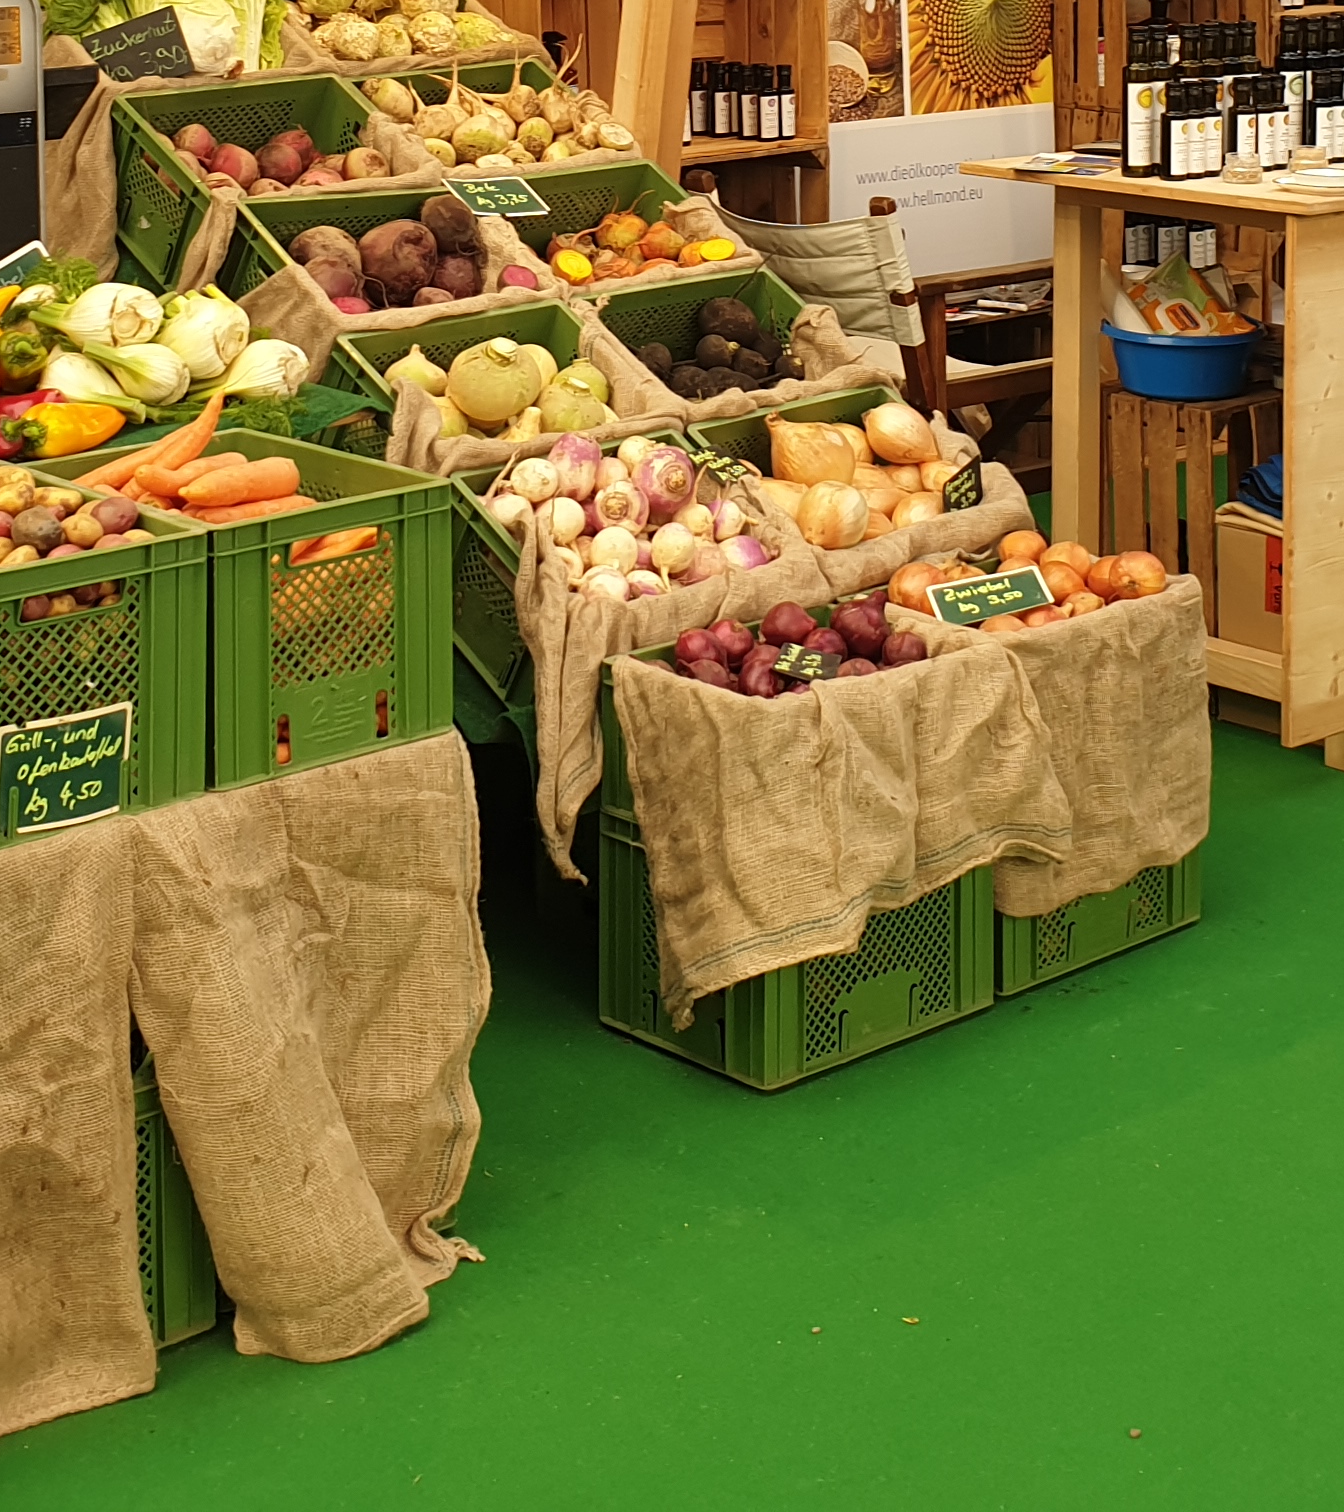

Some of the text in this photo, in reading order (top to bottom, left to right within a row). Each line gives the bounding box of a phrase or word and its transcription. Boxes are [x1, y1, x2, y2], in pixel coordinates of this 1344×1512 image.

[90, 12, 177, 61] Zuckerhut
[943, 578, 1011, 602] Zwiebel
[63, 718, 100, 745] und
[24, 780, 103, 822] kg 4,50
